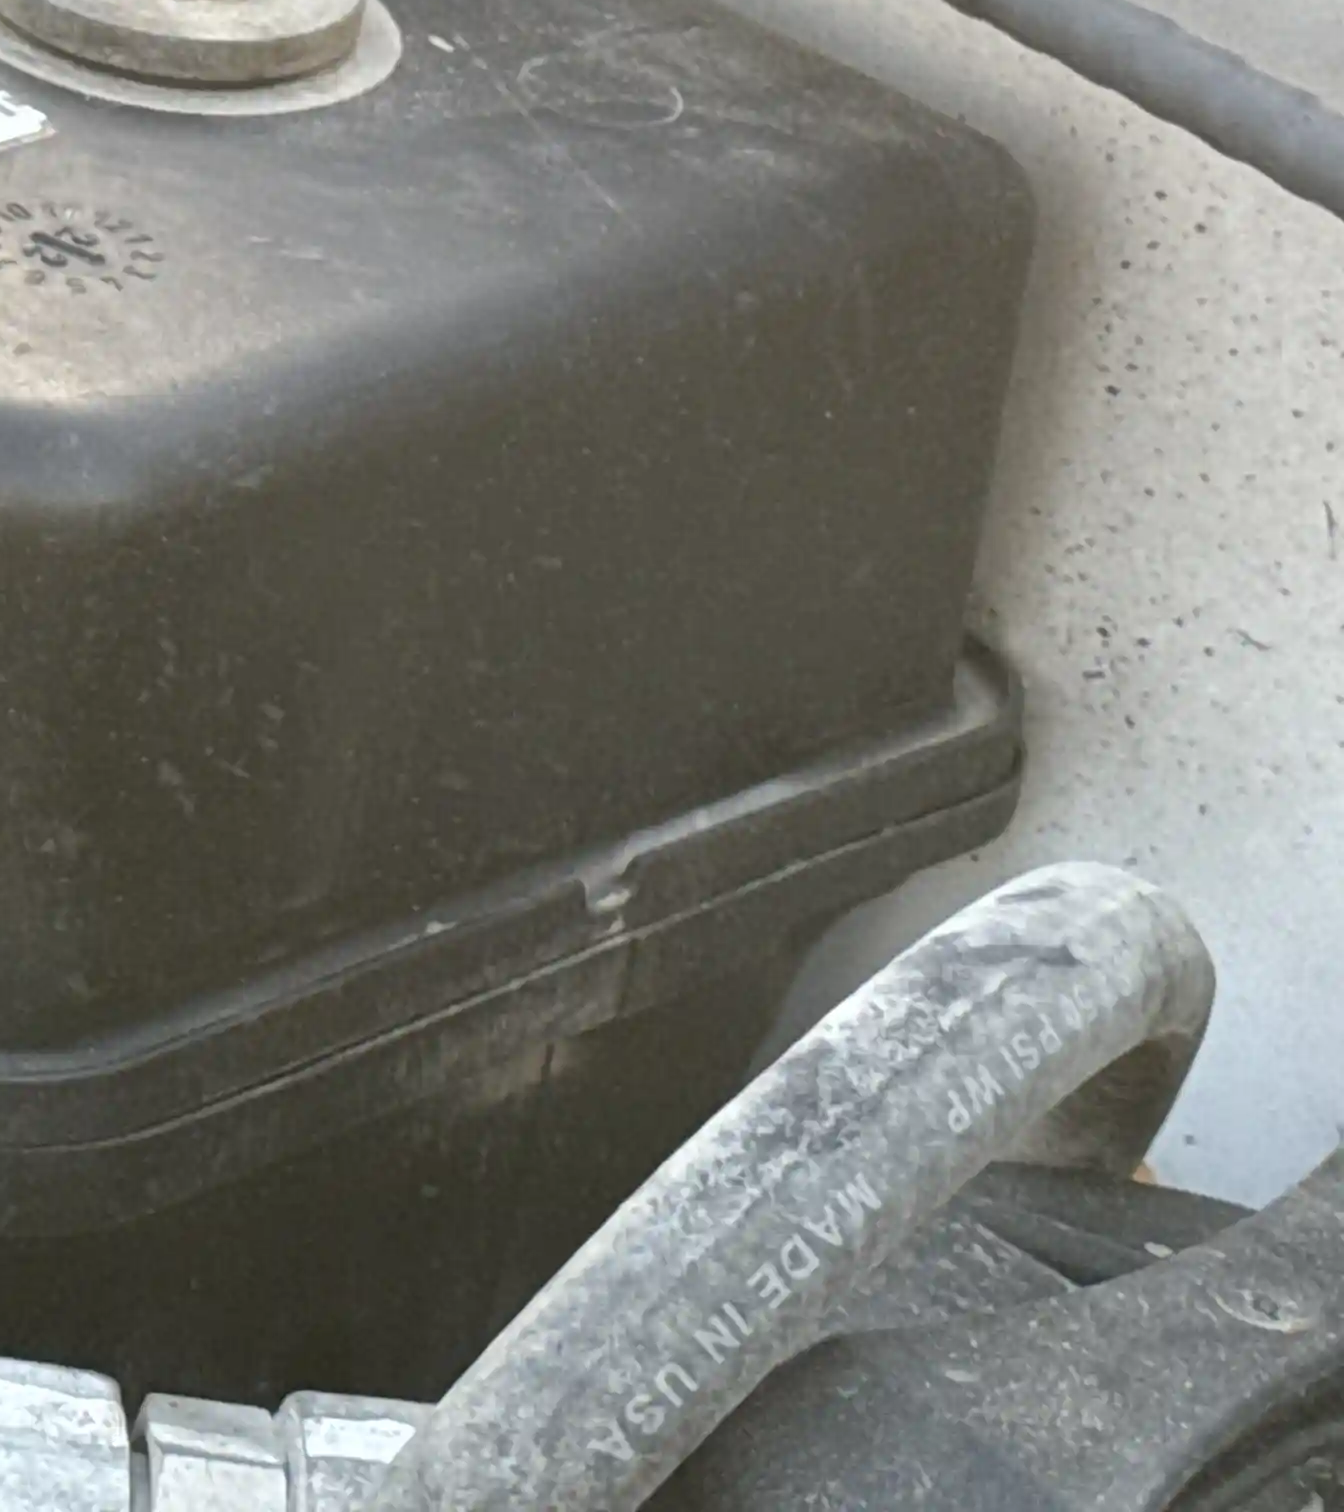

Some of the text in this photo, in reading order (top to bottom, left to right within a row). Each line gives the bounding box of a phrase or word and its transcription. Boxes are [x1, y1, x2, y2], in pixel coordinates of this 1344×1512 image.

[998, 1013, 1062, 1080] PSI
[948, 1063, 1005, 1133] WP
[747, 1172, 882, 1309] MADE
[693, 1301, 754, 1365] IN
[586, 1361, 698, 1462] USA
